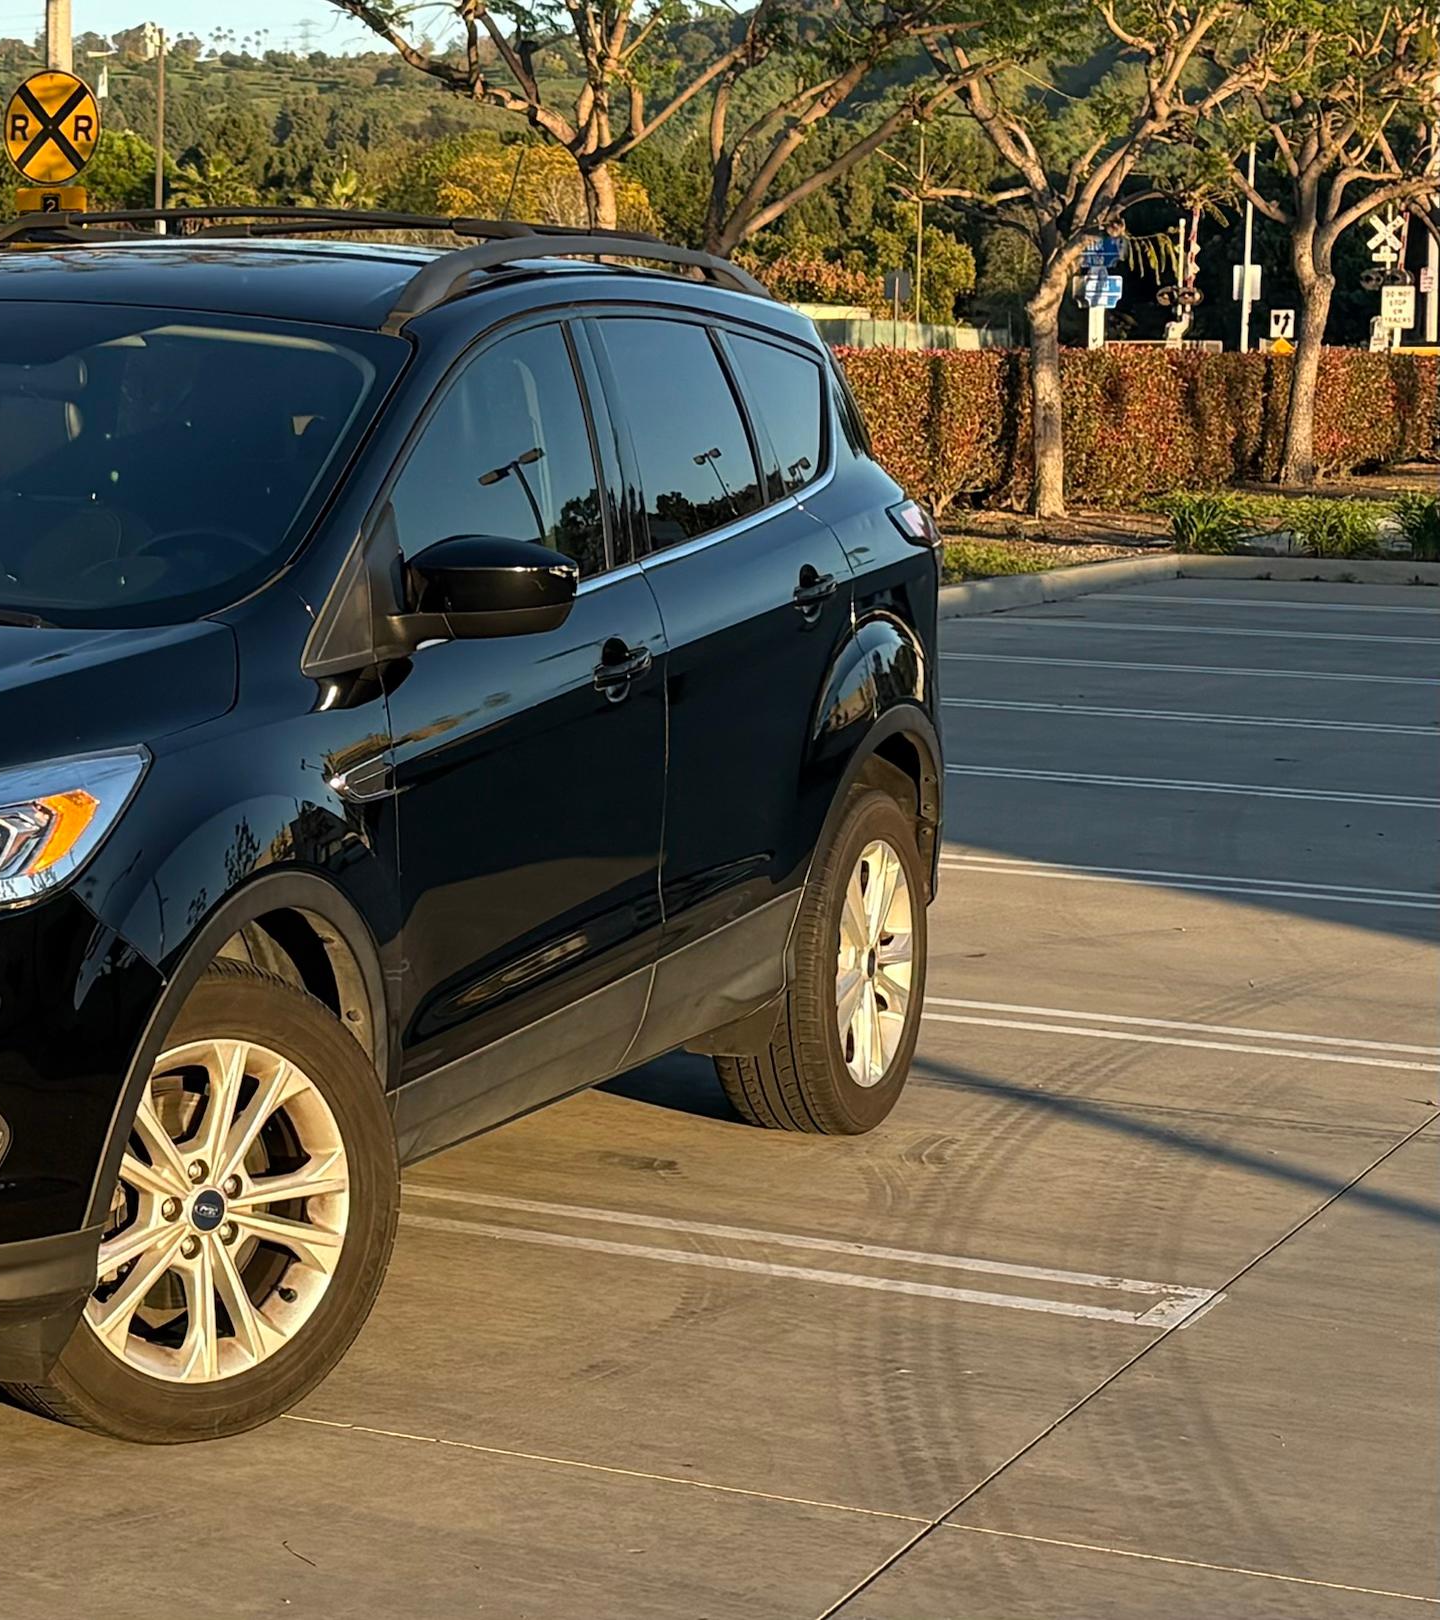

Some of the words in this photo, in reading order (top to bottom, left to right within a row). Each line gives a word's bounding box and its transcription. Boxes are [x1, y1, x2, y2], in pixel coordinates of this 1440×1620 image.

[11, 114, 29, 141] R
[74, 115, 92, 141] R
[46, 199, 56, 213] 2
